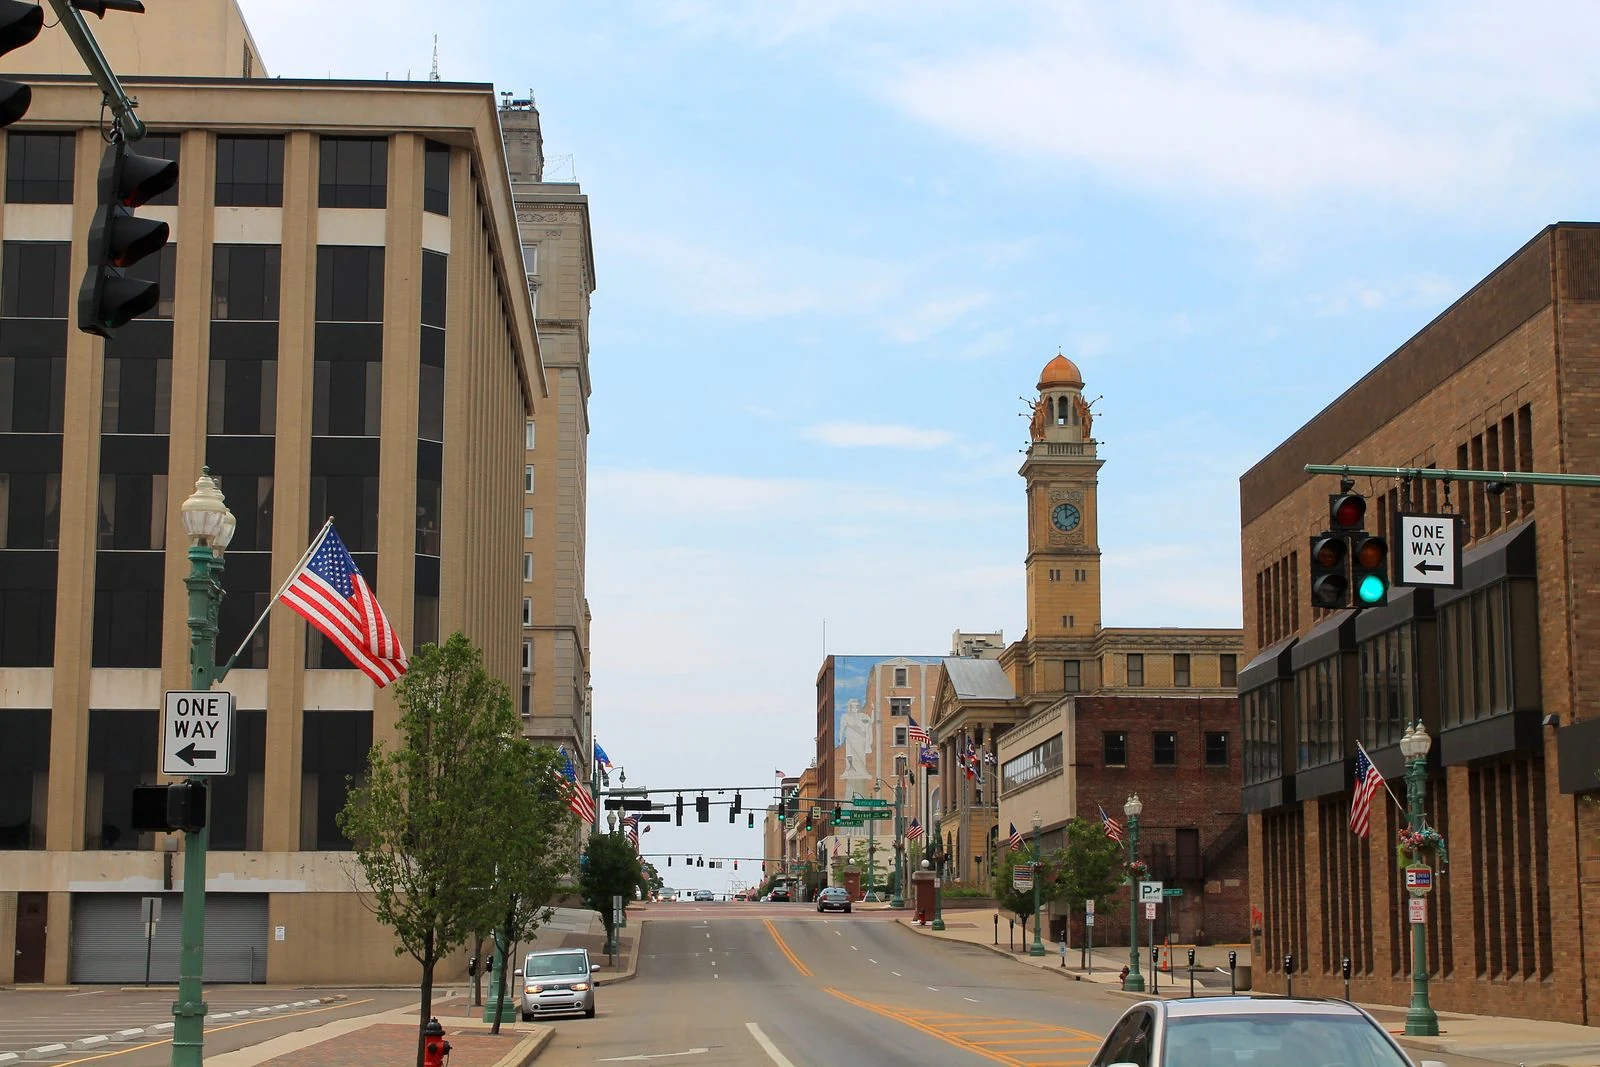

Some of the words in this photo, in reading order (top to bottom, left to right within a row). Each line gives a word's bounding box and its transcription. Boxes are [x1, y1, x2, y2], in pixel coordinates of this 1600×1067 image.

[1412, 525, 1444, 539] ONE
[1411, 542, 1446, 556] WAY
[177, 698, 218, 716] ONE
[174, 720, 220, 738] WAY
